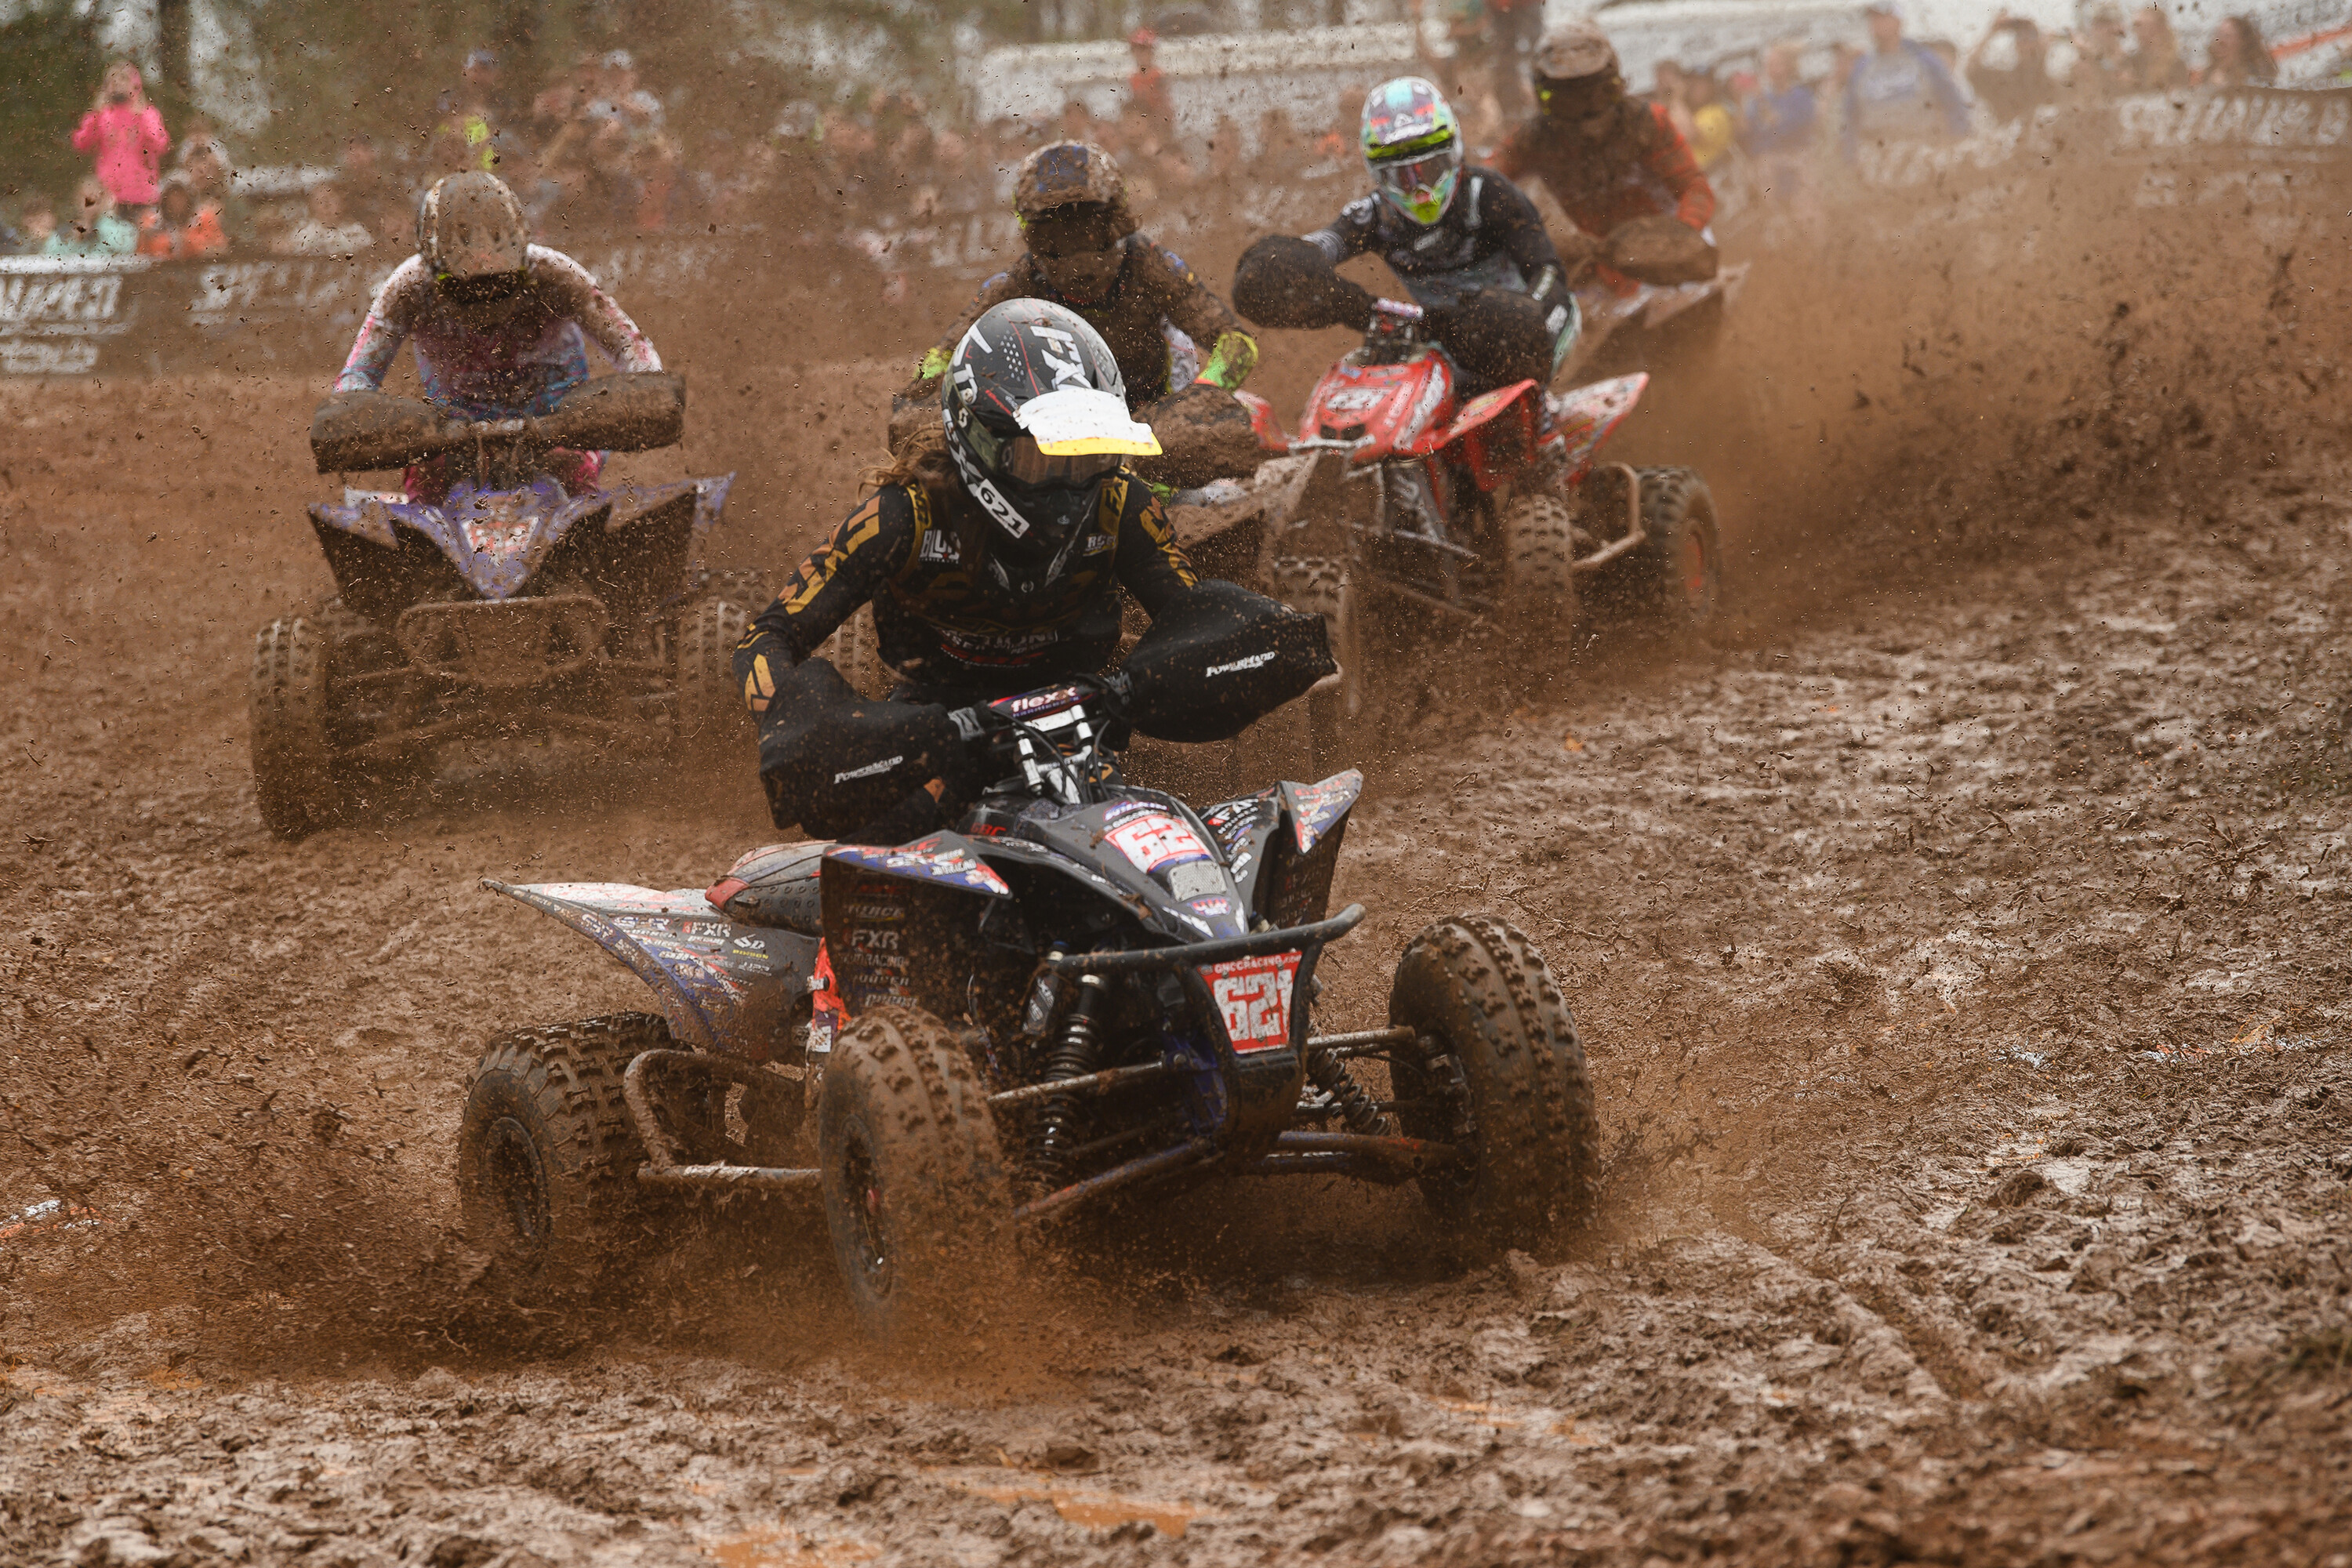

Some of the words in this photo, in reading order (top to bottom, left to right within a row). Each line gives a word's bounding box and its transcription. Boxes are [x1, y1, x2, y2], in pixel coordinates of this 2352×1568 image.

[981, 486, 1027, 533] 621
[691, 921, 732, 938] FXR
[851, 929, 899, 949] FXR
[1213, 969, 1293, 1042] 621
